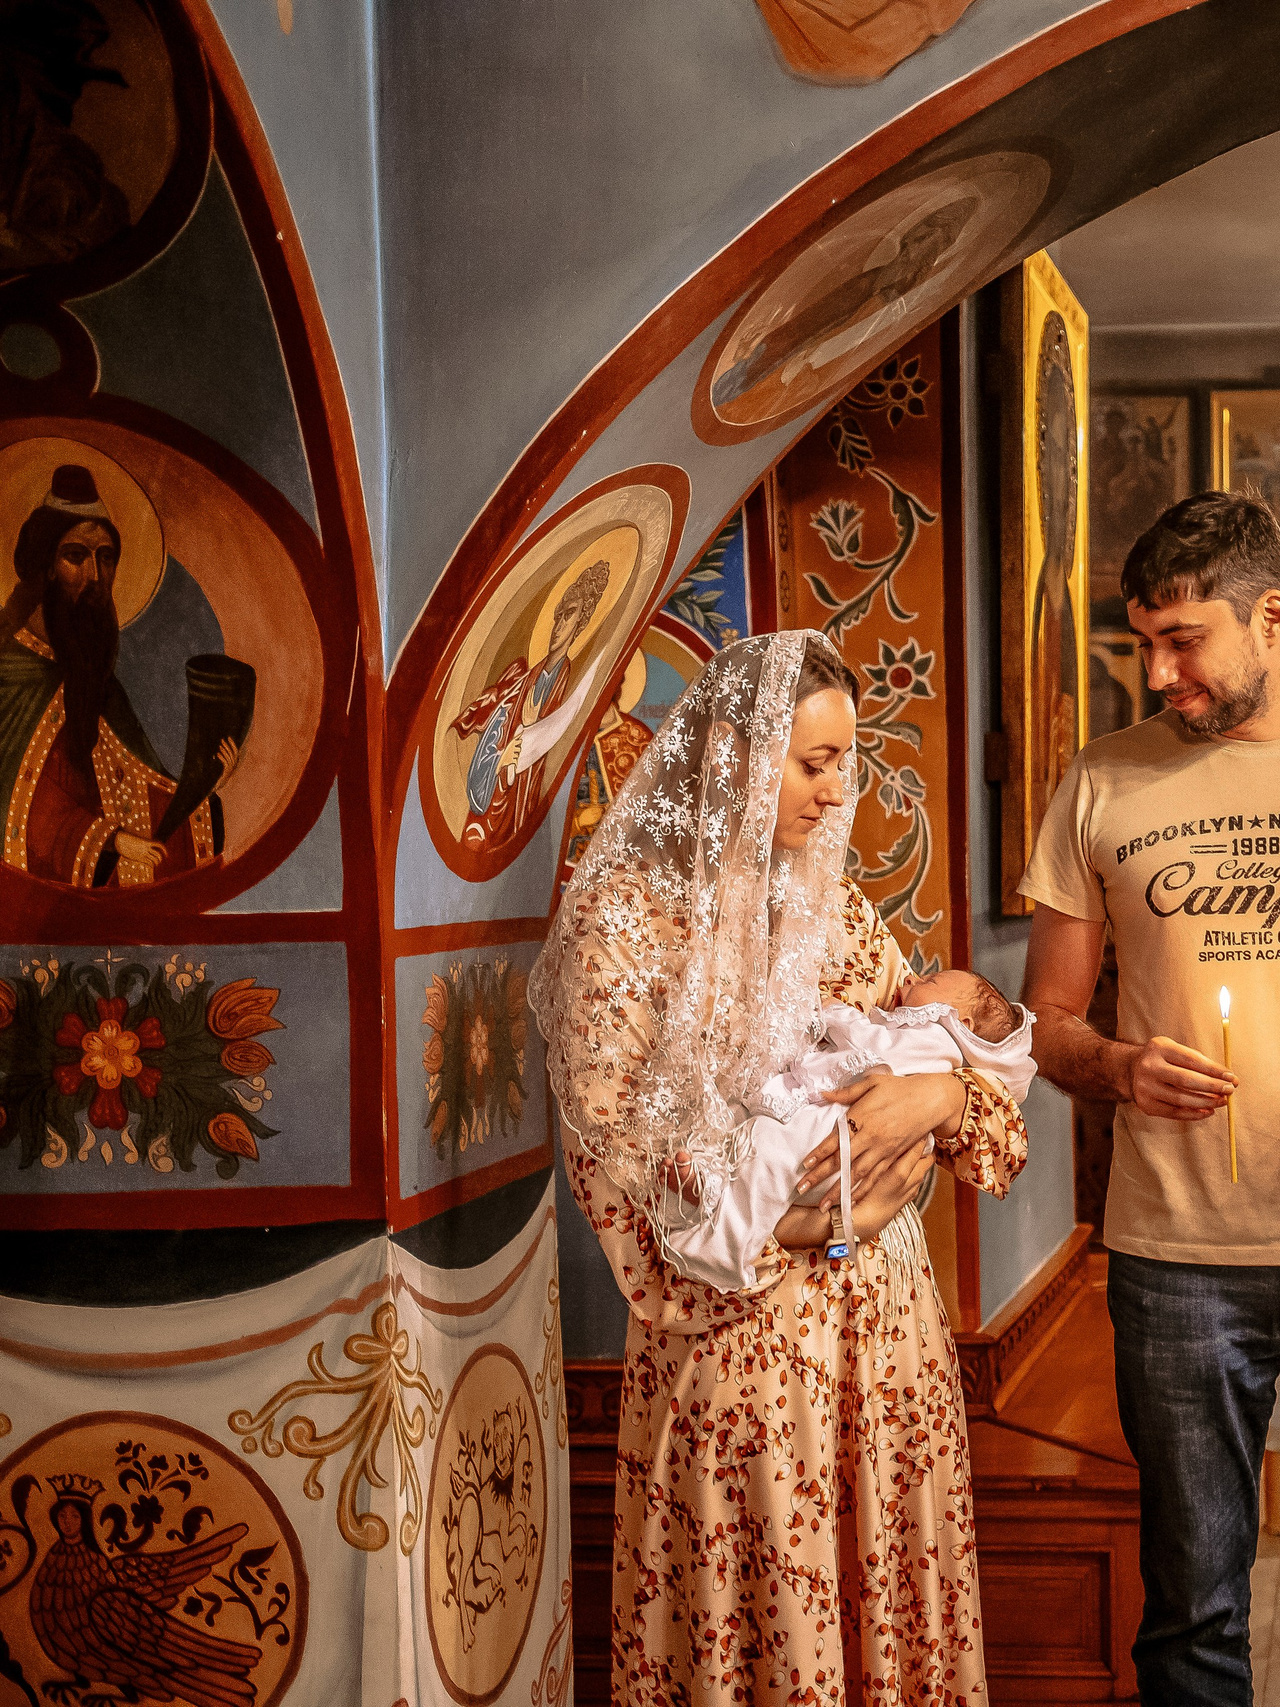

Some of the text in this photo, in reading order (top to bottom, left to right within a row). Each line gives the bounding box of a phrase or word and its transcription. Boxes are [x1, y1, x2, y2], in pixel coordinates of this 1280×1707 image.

[1116, 814, 1244, 865] BROOKLYN
[1231, 836, 1280, 857] 1988
[1203, 929, 1274, 947] ATHLETIC
[1198, 947, 1252, 962] SPORTS
